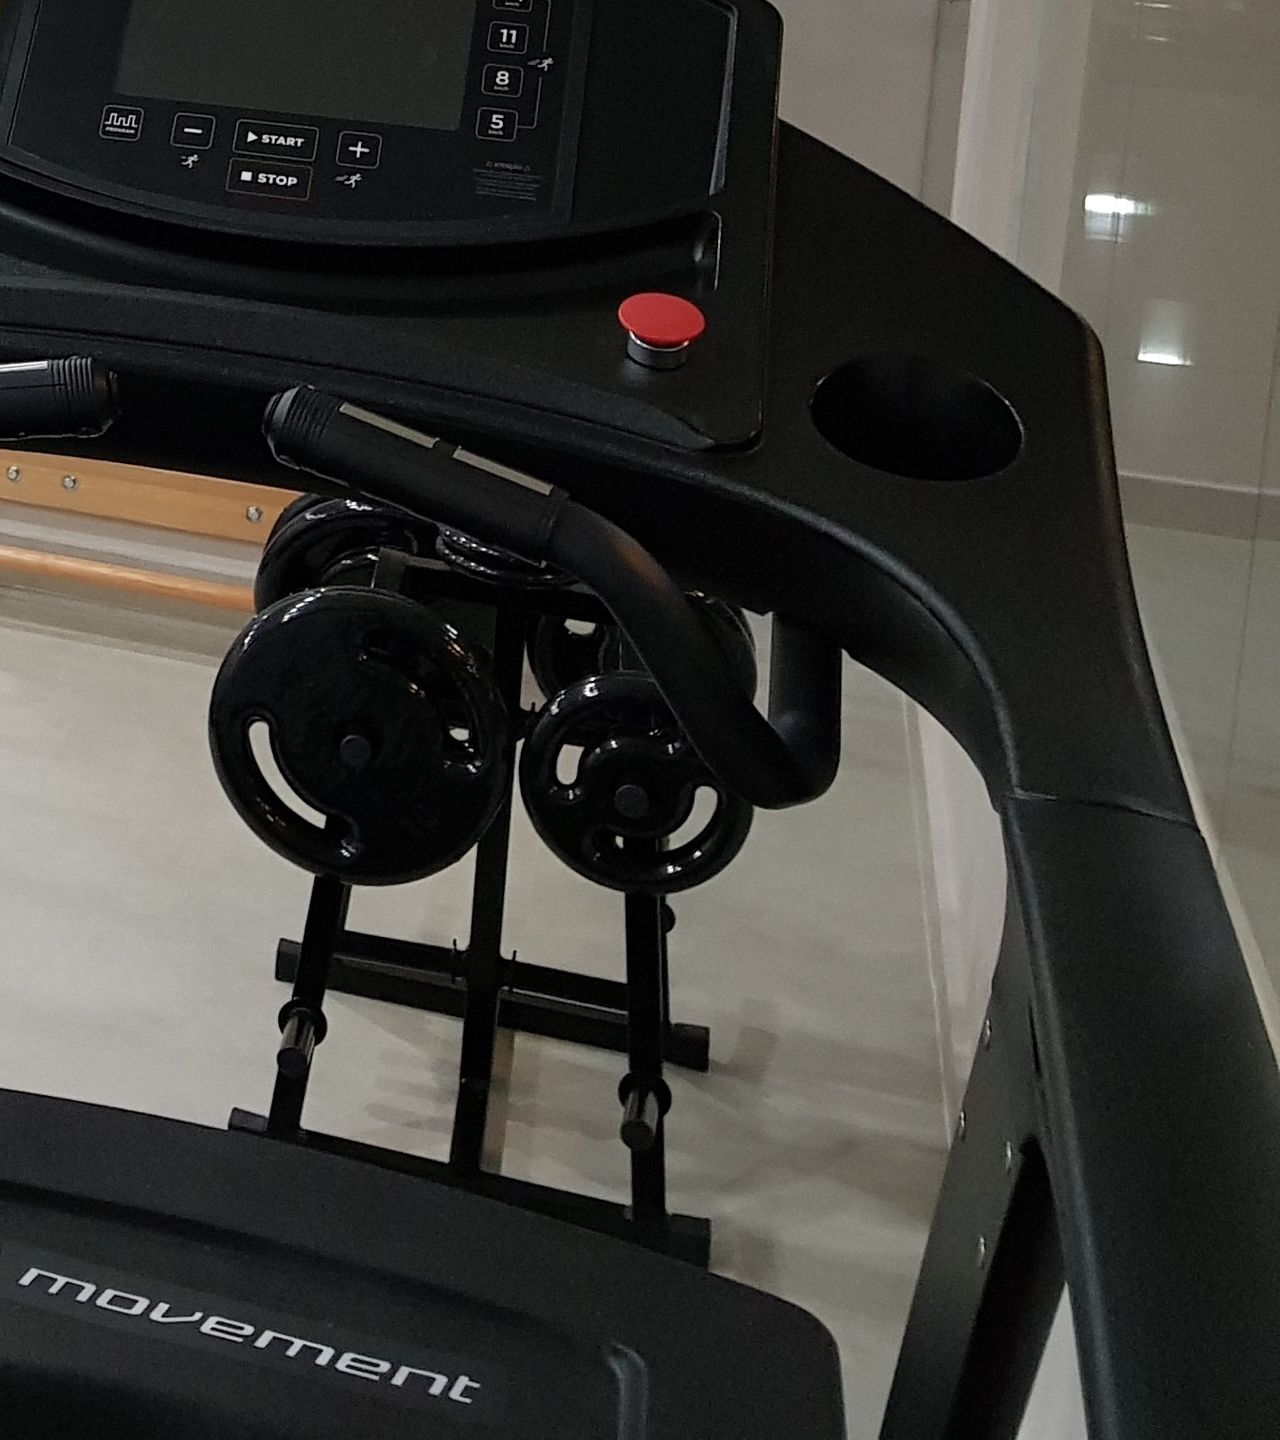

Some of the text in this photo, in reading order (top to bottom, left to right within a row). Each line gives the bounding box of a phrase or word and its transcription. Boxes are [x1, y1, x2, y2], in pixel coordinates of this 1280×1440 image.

[500, 29, 517, 44] 11
[495, 70, 510, 85] 8
[490, 114, 504, 129] 5
[261, 134, 305, 148] START
[257, 172, 298, 187] STOP
[17, 1266, 481, 1404] movement
